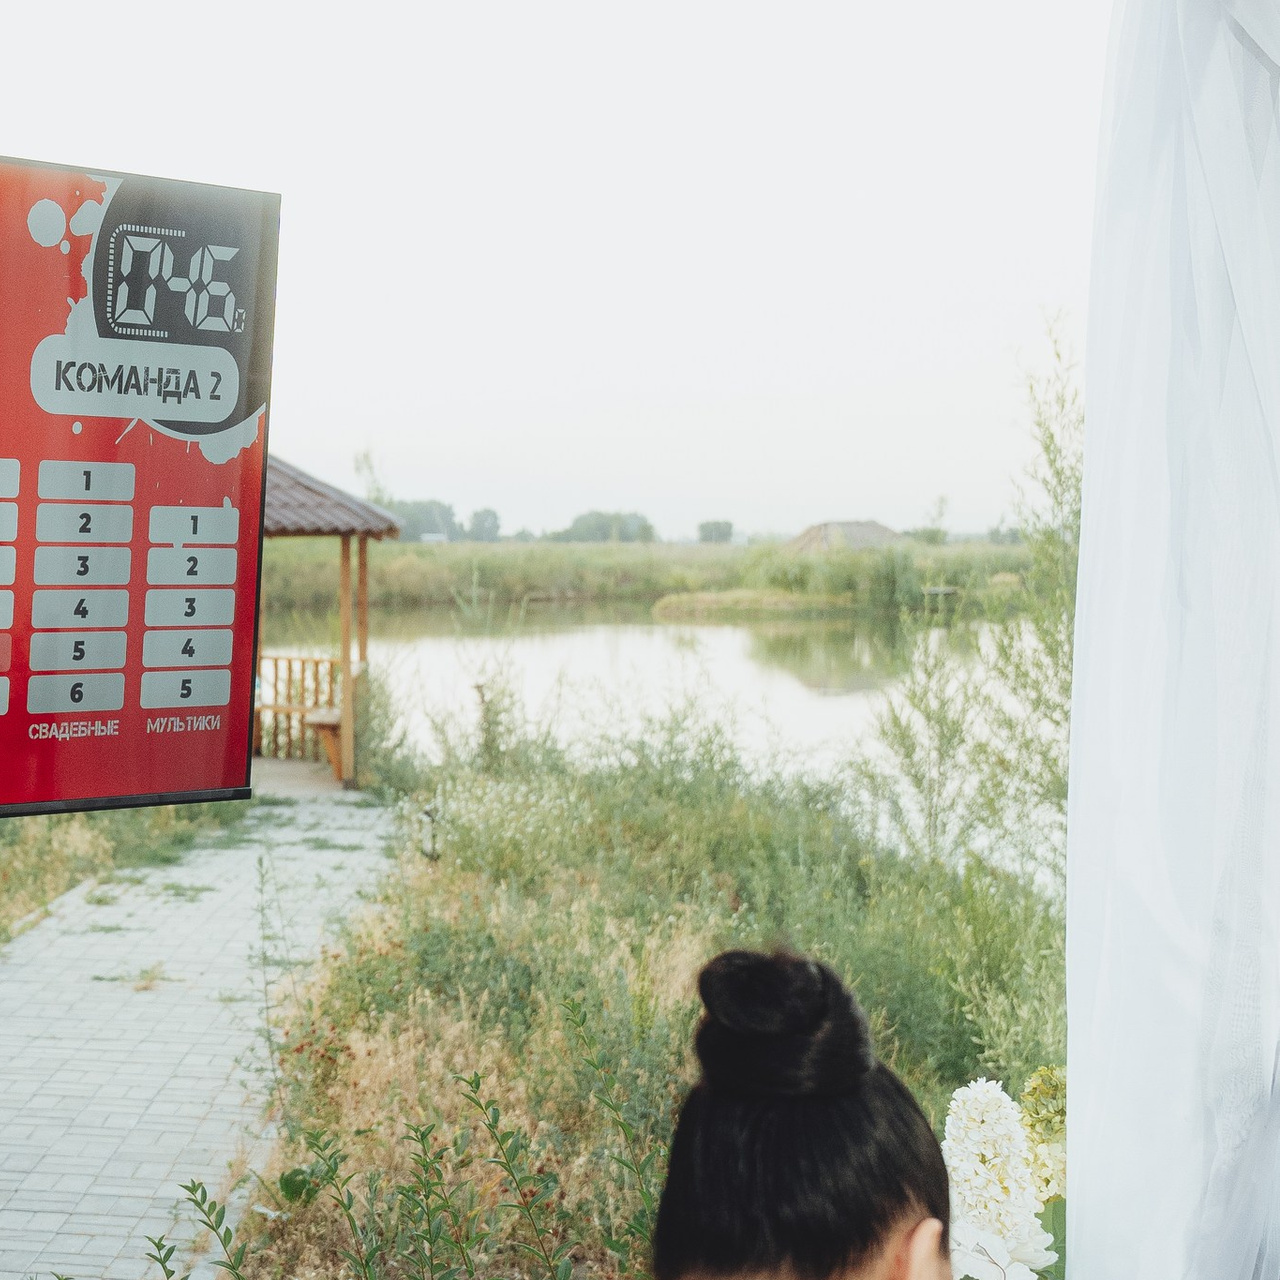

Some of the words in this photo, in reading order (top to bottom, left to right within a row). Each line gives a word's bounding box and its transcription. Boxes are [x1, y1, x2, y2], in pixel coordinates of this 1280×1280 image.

[114, 235, 240, 333] 046
[54, 360, 201, 405] КОМАНДА
[209, 371, 223, 401] 2
[83, 470, 92, 491] 1
[78, 512, 92, 534] 2
[190, 515, 199, 535] 1
[76, 555, 90, 577] 3
[186, 556, 199, 576] 2
[73, 598, 89, 619] 4
[183, 597, 196, 618] 3
[72, 640, 86, 661] 5
[181, 638, 196, 658] 4
[70, 682, 84, 704] 6
[179, 678, 192, 699] 5
[28, 719, 120, 742] СВАДЕБНЫЕ
[146, 714, 221, 734] МУЛЬТИКИ
